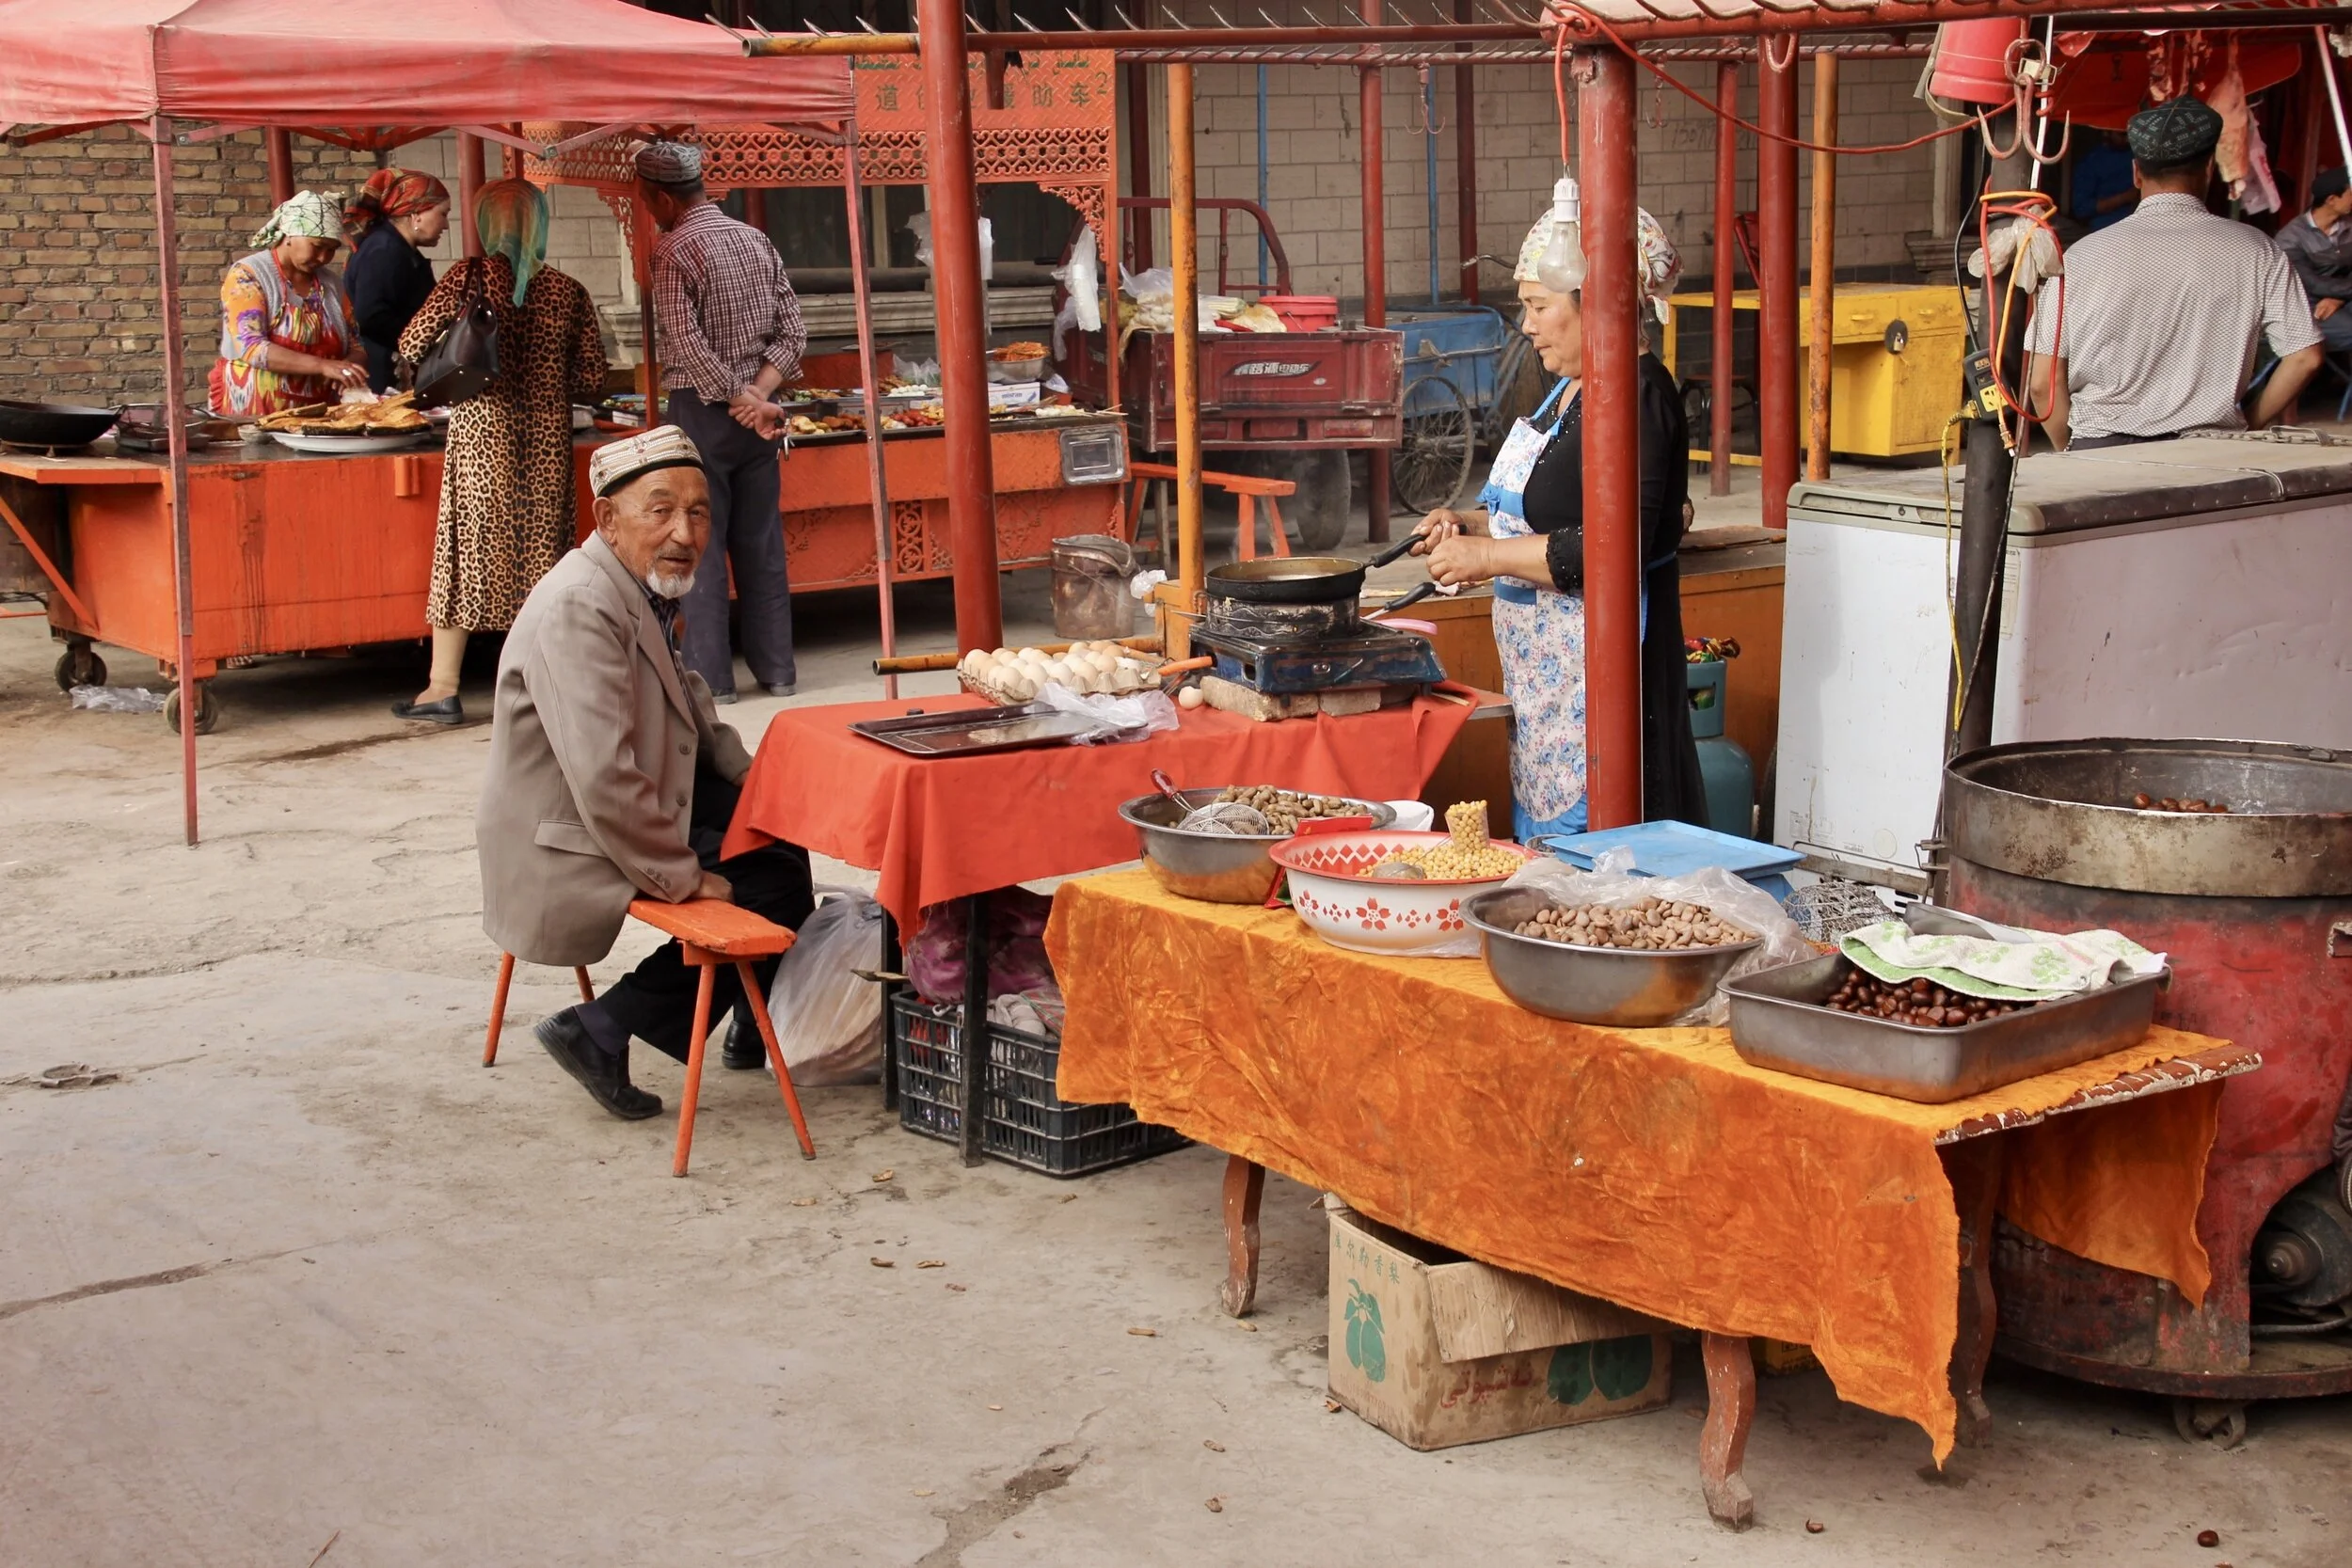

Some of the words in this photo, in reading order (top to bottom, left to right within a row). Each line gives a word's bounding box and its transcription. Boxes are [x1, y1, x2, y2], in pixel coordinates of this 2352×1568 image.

[877, 81, 1090, 111] 道助车
[1095, 71, 1108, 95] 2
